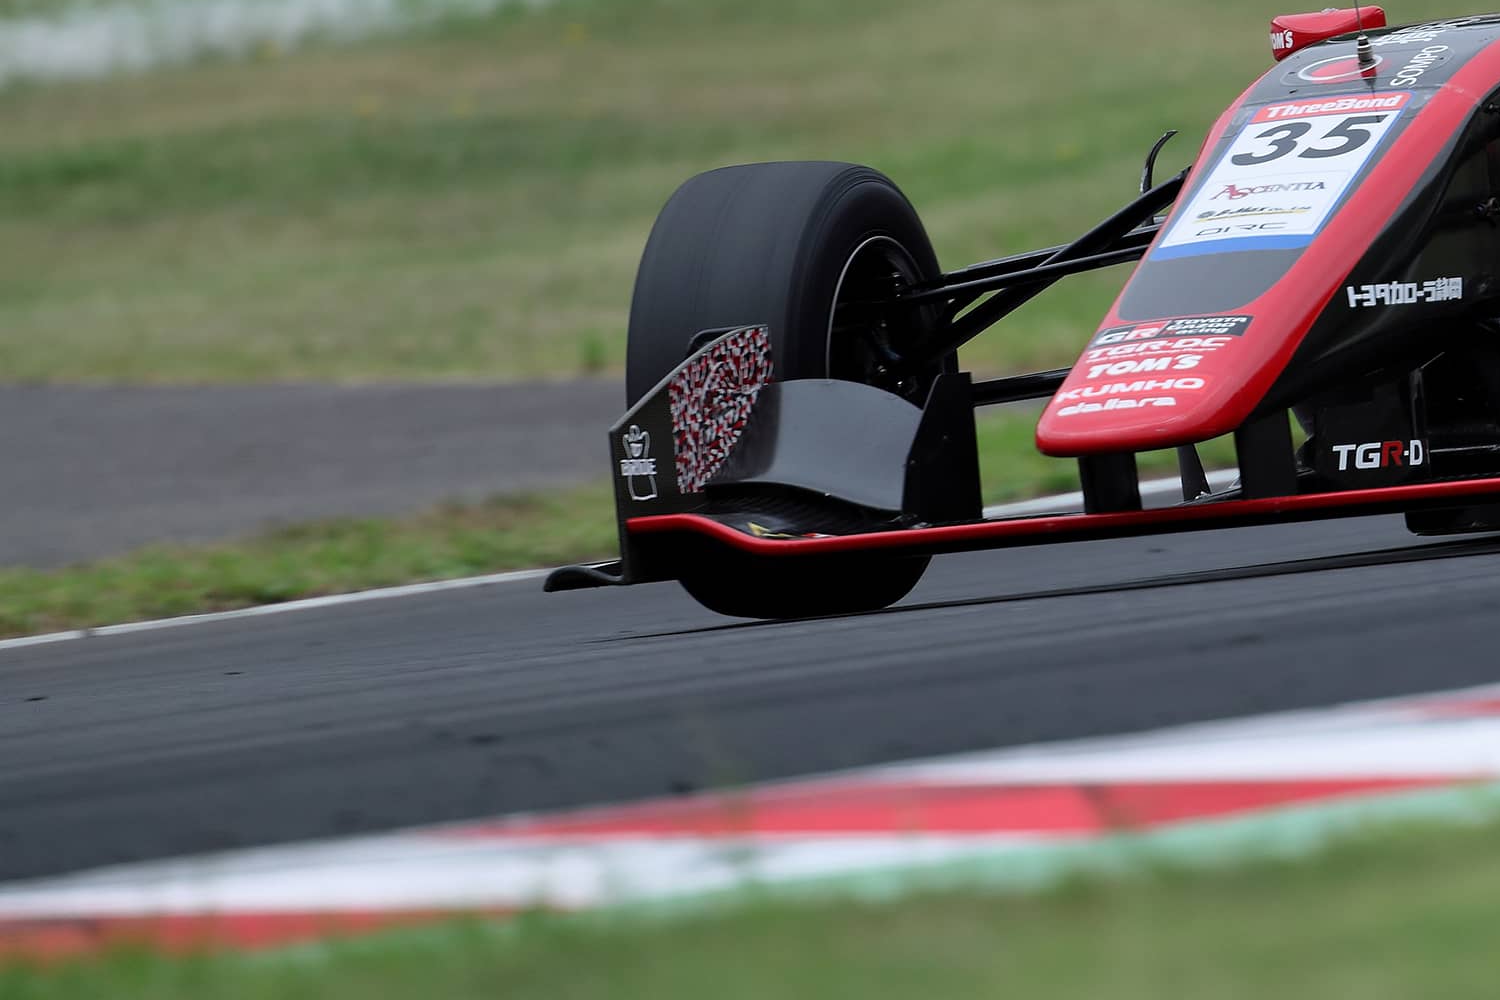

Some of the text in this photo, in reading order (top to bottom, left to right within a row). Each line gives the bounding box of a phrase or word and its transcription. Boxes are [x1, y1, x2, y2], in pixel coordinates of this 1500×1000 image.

[1270, 29, 1293, 50] OM'S
[1390, 45, 1448, 86] SOMPO
[1267, 95, 1403, 118] ThreeBond
[1231, 114, 1389, 166] 35
[1209, 182, 1327, 200] ASCENTIA
[1174, 317, 1247, 325] TOYOTA
[1096, 327, 1160, 345] GR
[1087, 354, 1203, 379] TOM'S
[1056, 377, 1204, 403] KUMHO
[1057, 397, 1176, 416] dallara
